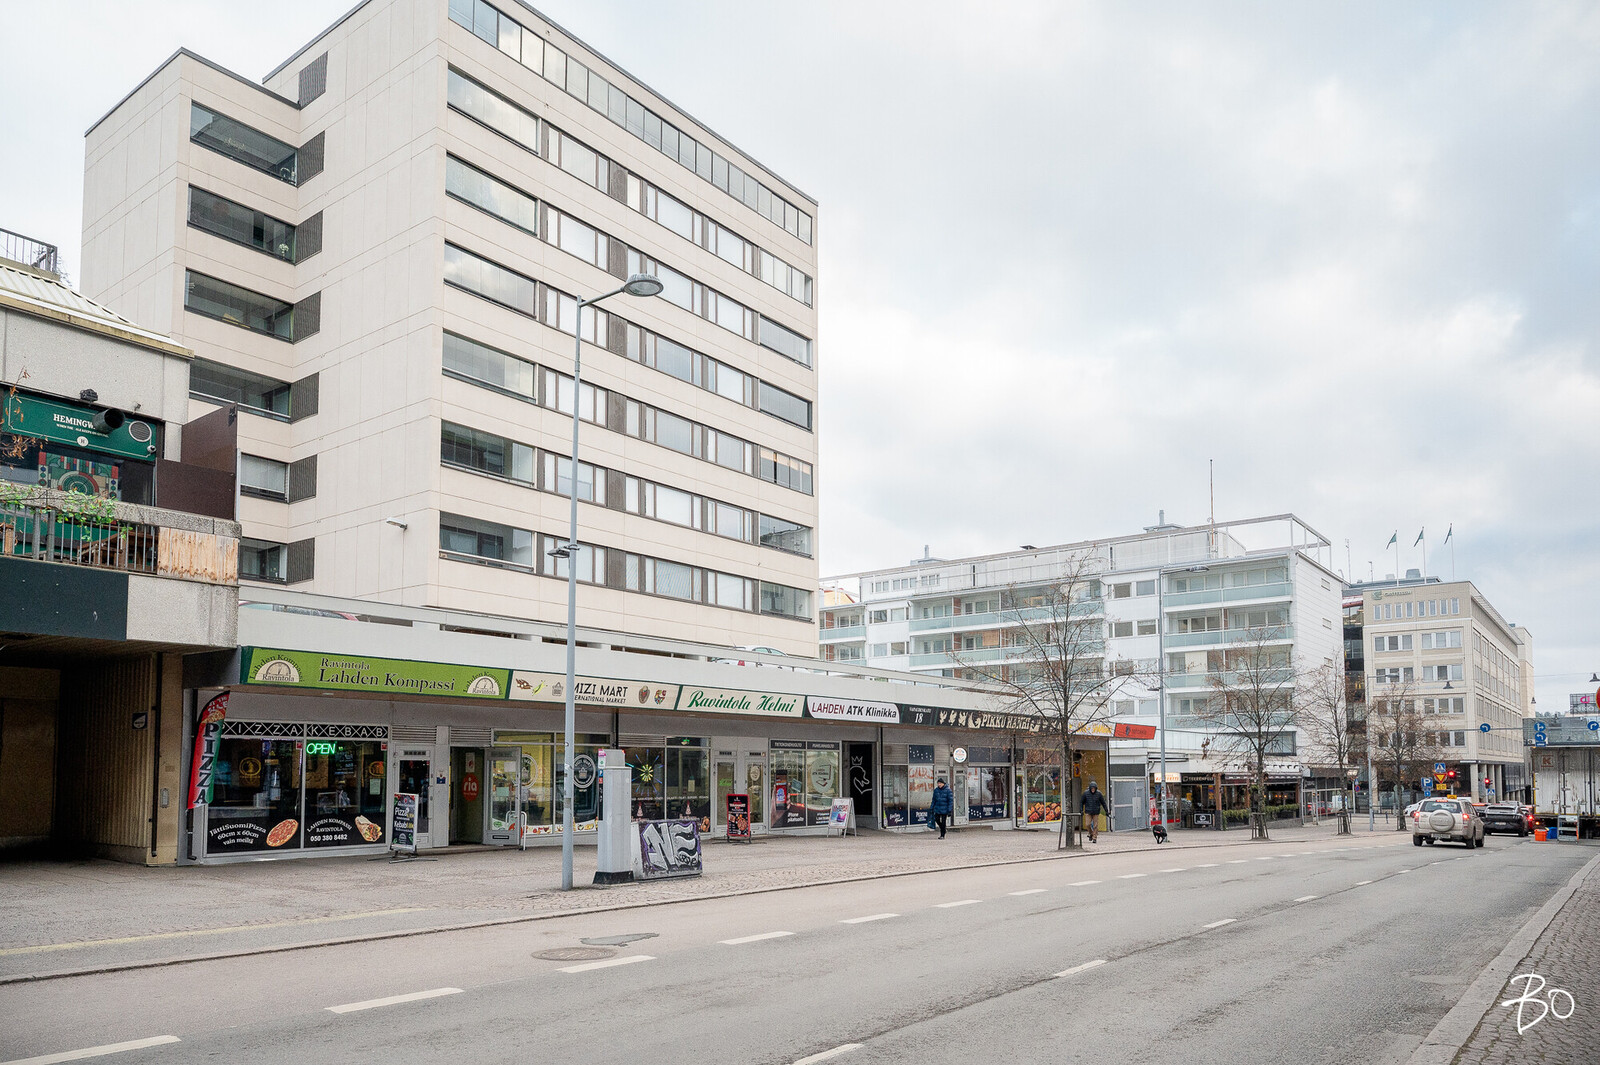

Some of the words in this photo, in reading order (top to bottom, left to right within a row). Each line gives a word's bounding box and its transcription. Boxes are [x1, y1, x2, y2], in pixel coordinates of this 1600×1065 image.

[53, 413, 95, 429] HEMINGW
[320, 657, 370, 670] Ravintola
[318, 668, 379, 686] Lahden
[384, 672, 456, 693] Kompassi
[599, 684, 629, 698] MART
[605, 697, 627, 705] MARKET
[687, 690, 752, 710] Ravintola
[756, 694, 797, 712] Helmi
[811, 702, 845, 715] LAHDEN
[846, 704, 864, 716] ATK
[865, 706, 897, 719] Klinikka
[914, 713, 924, 724] 18
[980, 713, 1007, 728] PIKKU
[311, 726, 383, 737] KEBAB
[306, 743, 336, 755] OPEN
[194, 722, 220, 805] PIZZA
[306, 818, 328, 832] LAHDEN
[328, 818, 352, 831] KOMPASSI
[241, 829, 260, 839] 60cm
[333, 833, 348, 841] 8482
